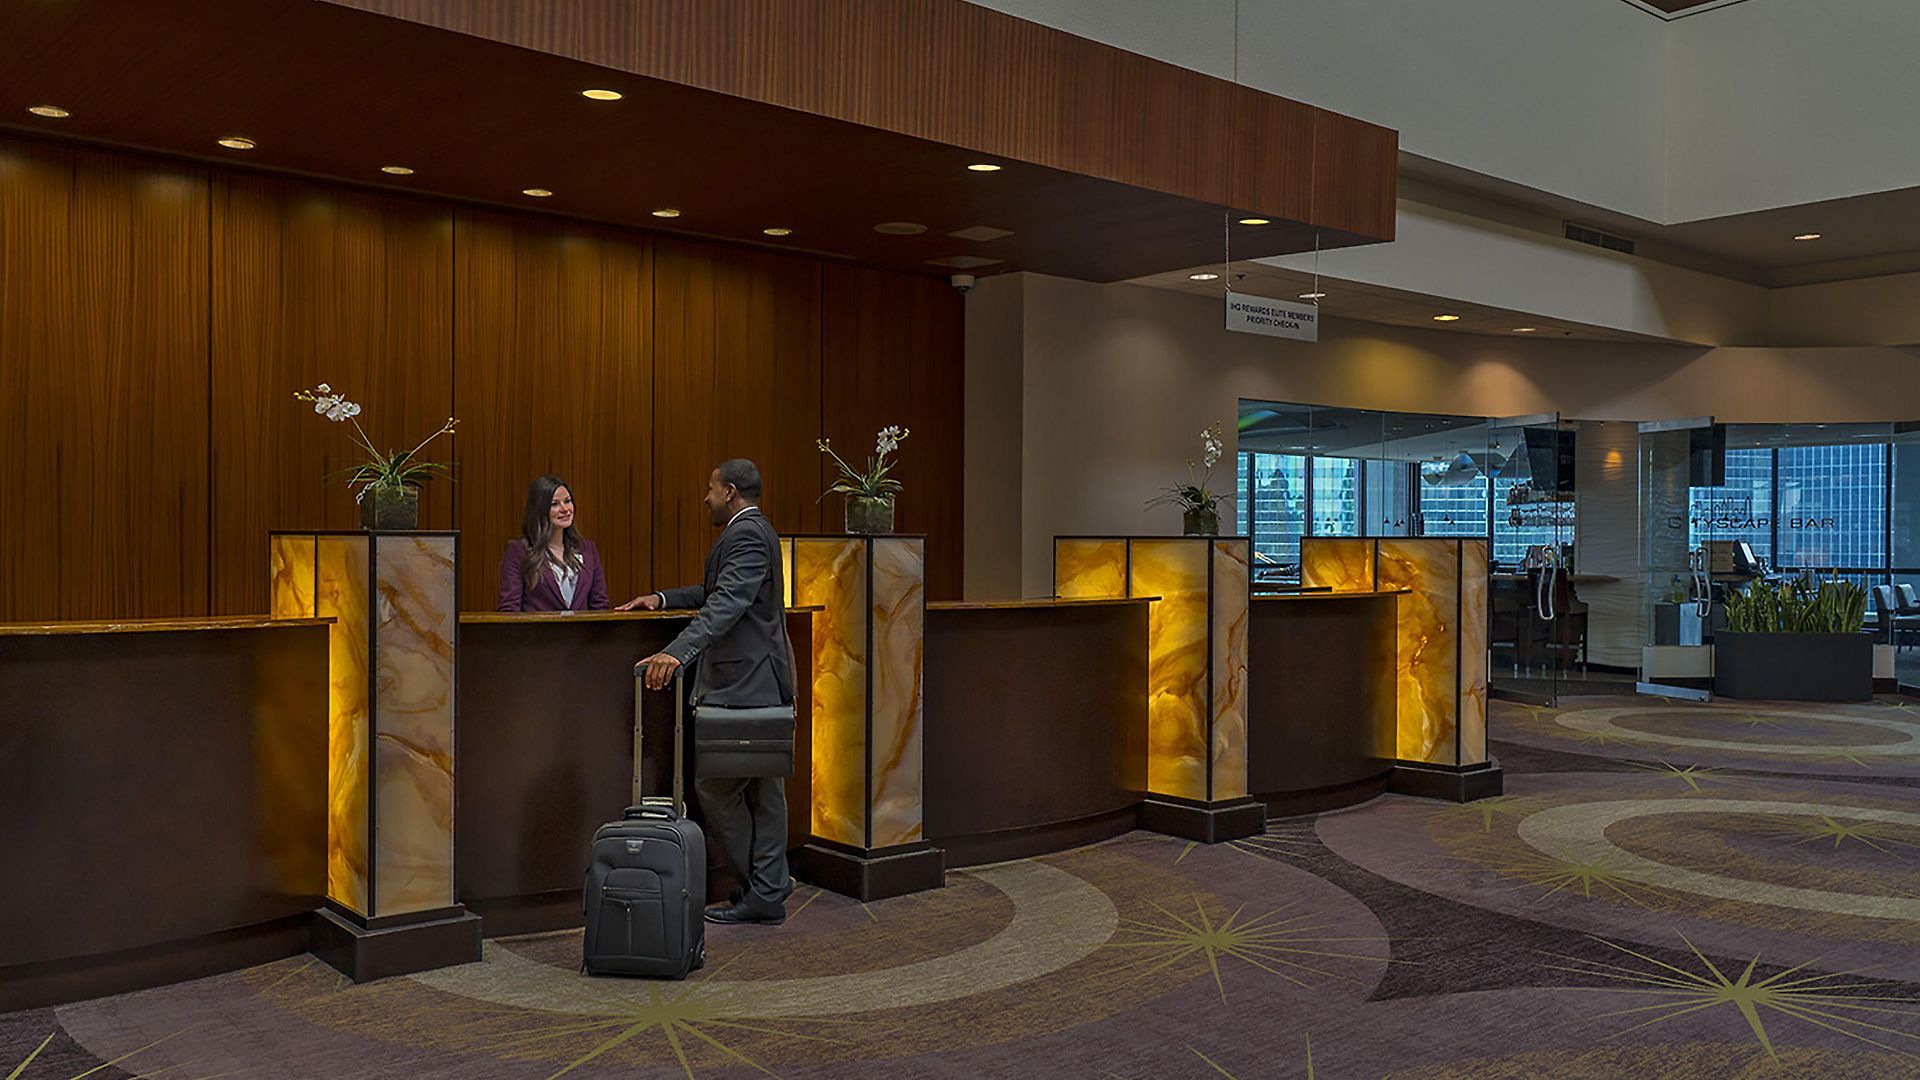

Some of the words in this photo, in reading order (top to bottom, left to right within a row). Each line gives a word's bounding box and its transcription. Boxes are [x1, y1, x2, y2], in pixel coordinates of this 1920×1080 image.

[1242, 304, 1270, 315] REWARDS
[1271, 308, 1286, 318] ELITE
[1287, 311, 1314, 322] MEMBERS
[1246, 315, 1272, 325] PRIORITY
[1668, 516, 1780, 529] CTYSCAP
[1790, 517, 1834, 529] BAR
